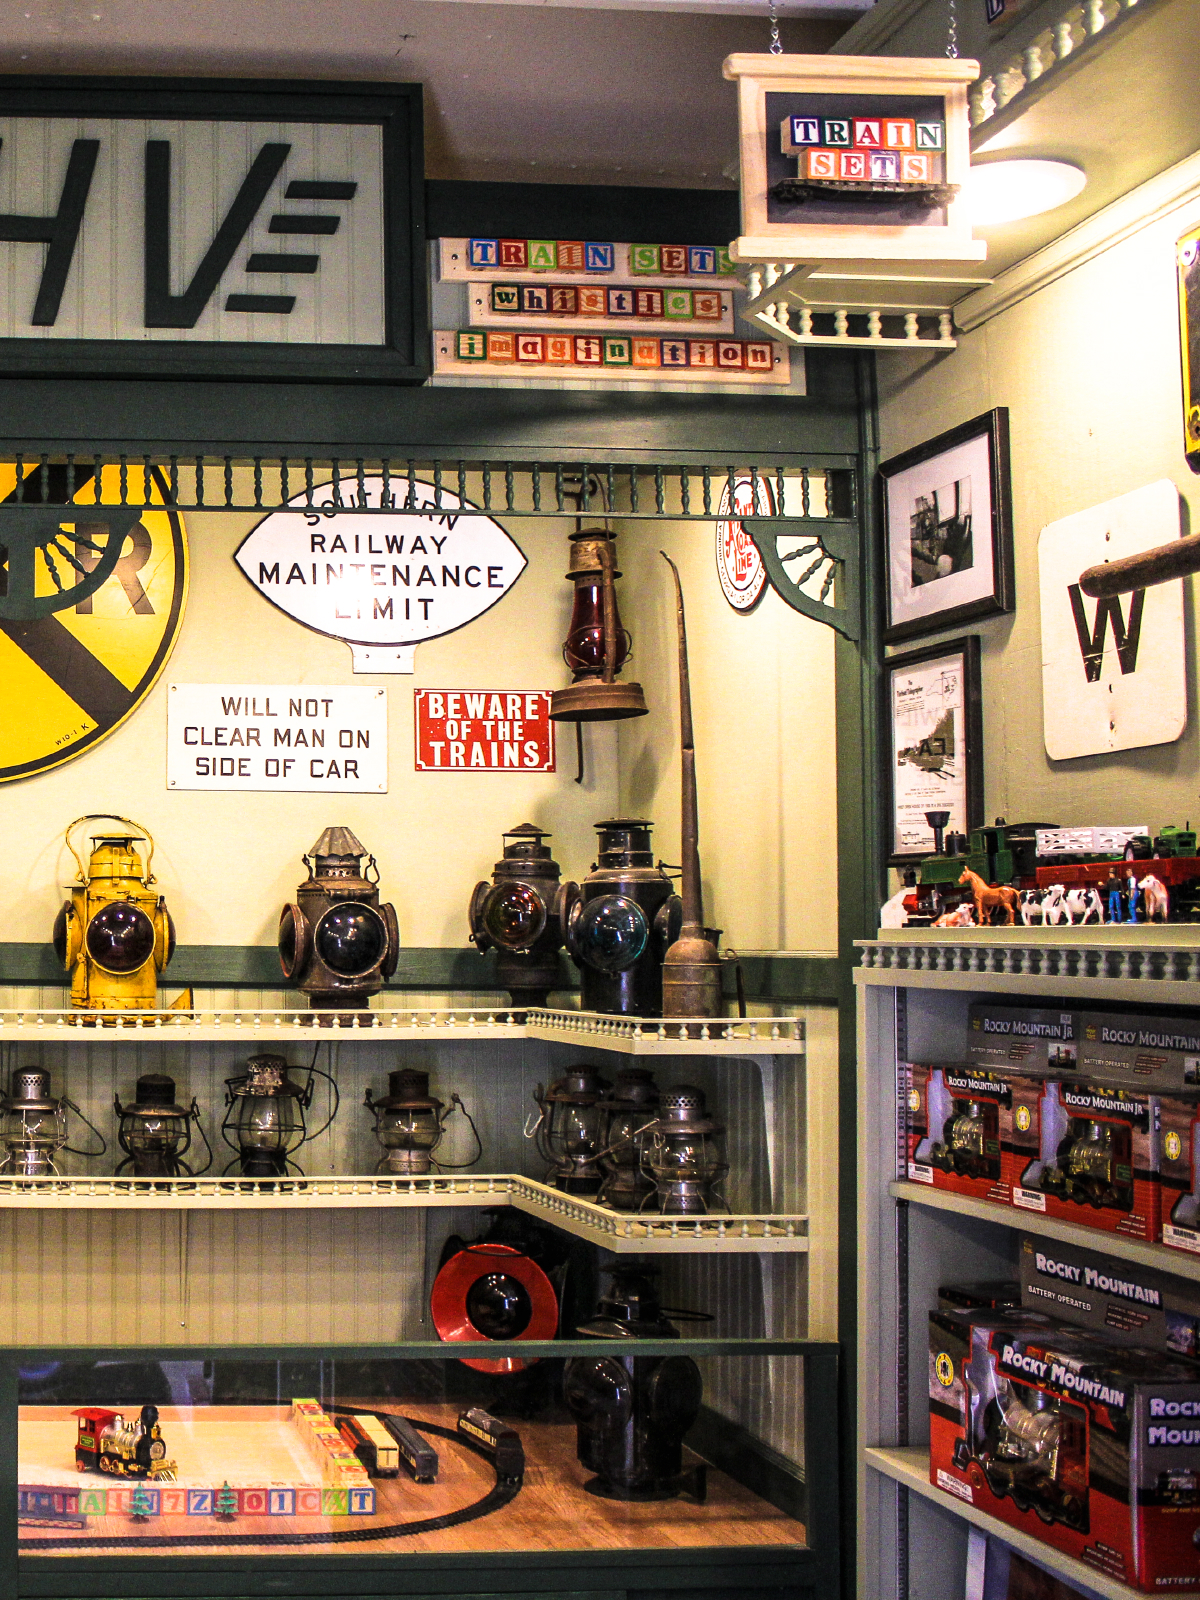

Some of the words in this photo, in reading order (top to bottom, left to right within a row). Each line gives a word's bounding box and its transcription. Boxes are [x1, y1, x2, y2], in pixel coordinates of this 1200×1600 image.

[796, 120, 940, 147] TRAIN
[813, 153, 925, 180] SETS
[474, 241, 612, 268] TRAIN
[638, 247, 737, 272] SETS
[496, 288, 716, 313] whistles
[464, 335, 769, 364] imagination
[310, 534, 448, 556] RAILWAY
[258, 561, 505, 589] MAINTENANCE
[334, 597, 435, 622] LIMIT
[1068, 583, 1146, 683] W
[221, 695, 278, 717] WILL
[289, 698, 333, 718] NOT
[429, 692, 541, 721] BEWARE
[184, 726, 262, 748] CLEAR
[273, 728, 326, 748] MAN
[338, 729, 370, 749] ON
[445, 718, 474, 741] OF
[482, 719, 525, 742] THE
[429, 739, 541, 768] TRAINS
[195, 757, 252, 777] SIDE
[264, 758, 296, 778] OF
[309, 759, 360, 779] CAR
[984, 1018, 1011, 1034] ROCKY
[1013, 1021, 1062, 1038] MOUNTAIN
[1102, 1027, 1137, 1044] ROCKY
[1139, 1031, 1200, 1050] MOUNTAIN
[948, 1075, 967, 1089] ROCKY
[968, 1078, 1001, 1093] MOUNTAIN
[1065, 1092, 1092, 1107] ROCKY
[1092, 1095, 1134, 1113] MOUNTAIN
[1035, 1252, 1082, 1282] ROCKY
[1084, 1266, 1161, 1306] MOUNTAIN
[1027, 1285, 1056, 1301] BATTERY
[1057, 1294, 1092, 1312] OPERATED
[1002, 1344, 1049, 1378] ROCKY
[1050, 1363, 1126, 1408] MOUNTAIN
